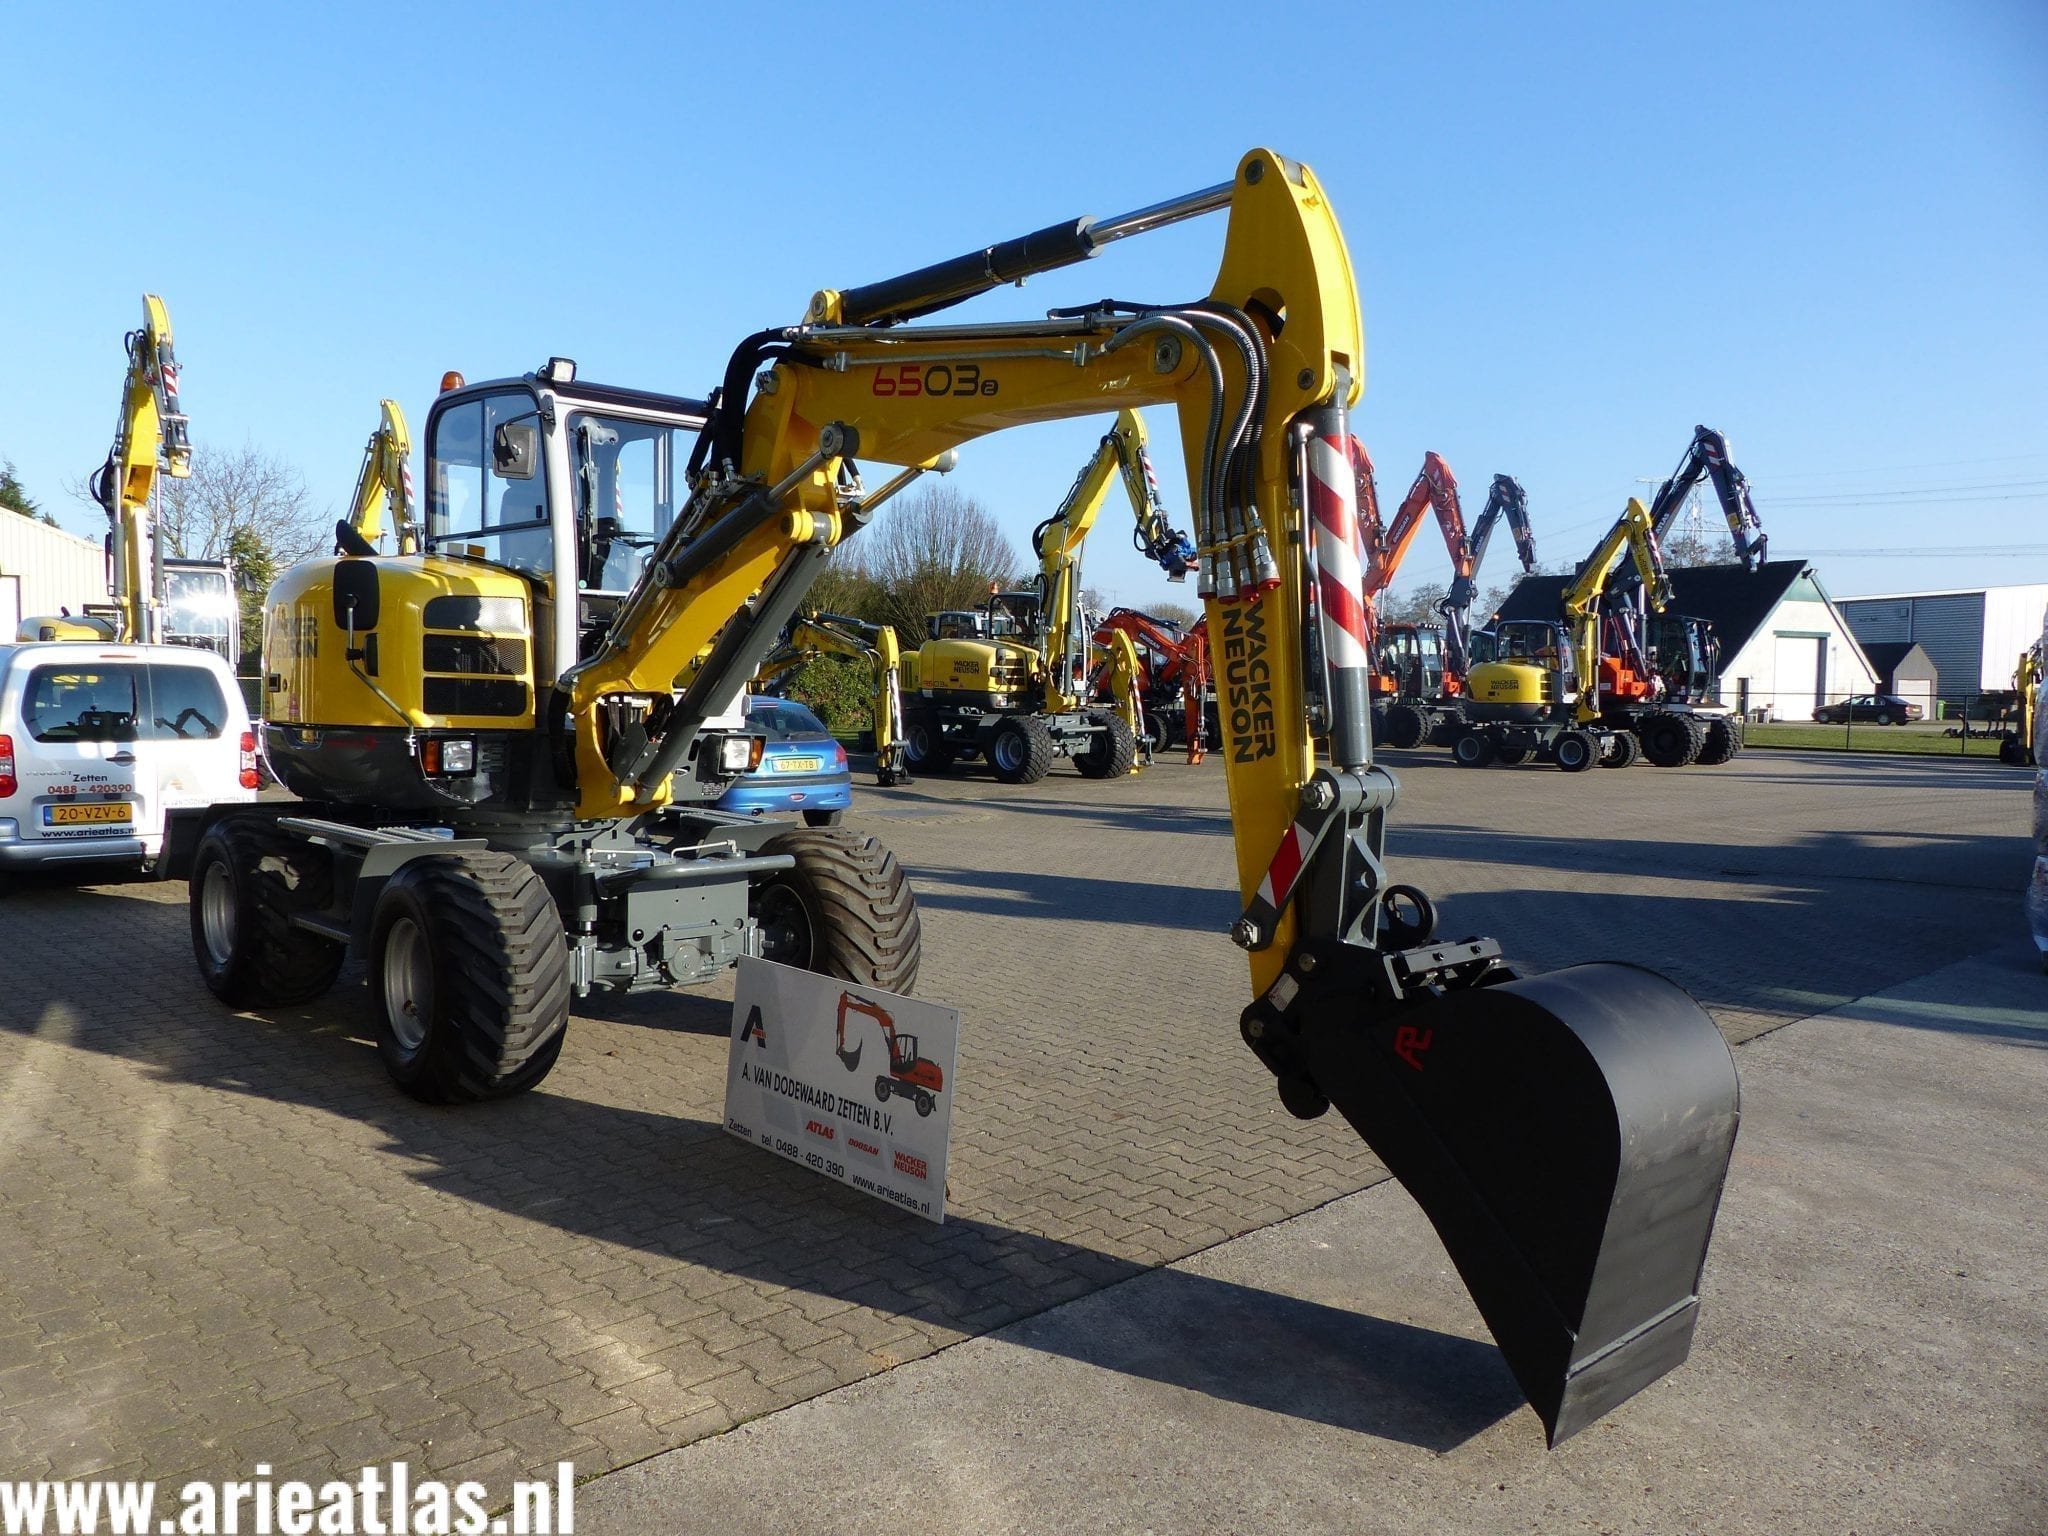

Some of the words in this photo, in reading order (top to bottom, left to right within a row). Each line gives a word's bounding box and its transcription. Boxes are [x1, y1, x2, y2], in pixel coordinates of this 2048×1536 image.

[873, 365, 980, 396] 6503
[953, 660, 980, 668] WACKER
[953, 667, 980, 675] NEUSON
[1222, 608, 1255, 764] NEUSON
[1244, 600, 1276, 762] WACKER
[72, 773, 108, 783] Zetten
[47, 784, 78, 795] 0488
[88, 783, 132, 794] 420390
[58, 806, 126, 821] 20-VZV-6
[41, 826, 138, 838] www.arieatlas.nl
[741, 1062, 751, 1082] A.
[754, 1065, 772, 1089] VAN
[773, 1073, 836, 1113] DODEWAARD
[836, 1097, 872, 1128] ZETTEN
[873, 1109, 894, 1137] B.V.
[805, 1120, 835, 1141] ATLAS
[848, 1137, 879, 1156] DOOSAN
[728, 1118, 752, 1139] Zetten
[775, 1138, 799, 1159] 0488
[805, 1151, 824, 1170] 420
[825, 1160, 845, 1179] 390
[852, 1173, 931, 1216] www.arieatlas.nl
[893, 1159, 928, 1181] NEUSON
[894, 1150, 928, 1171] WACKER
